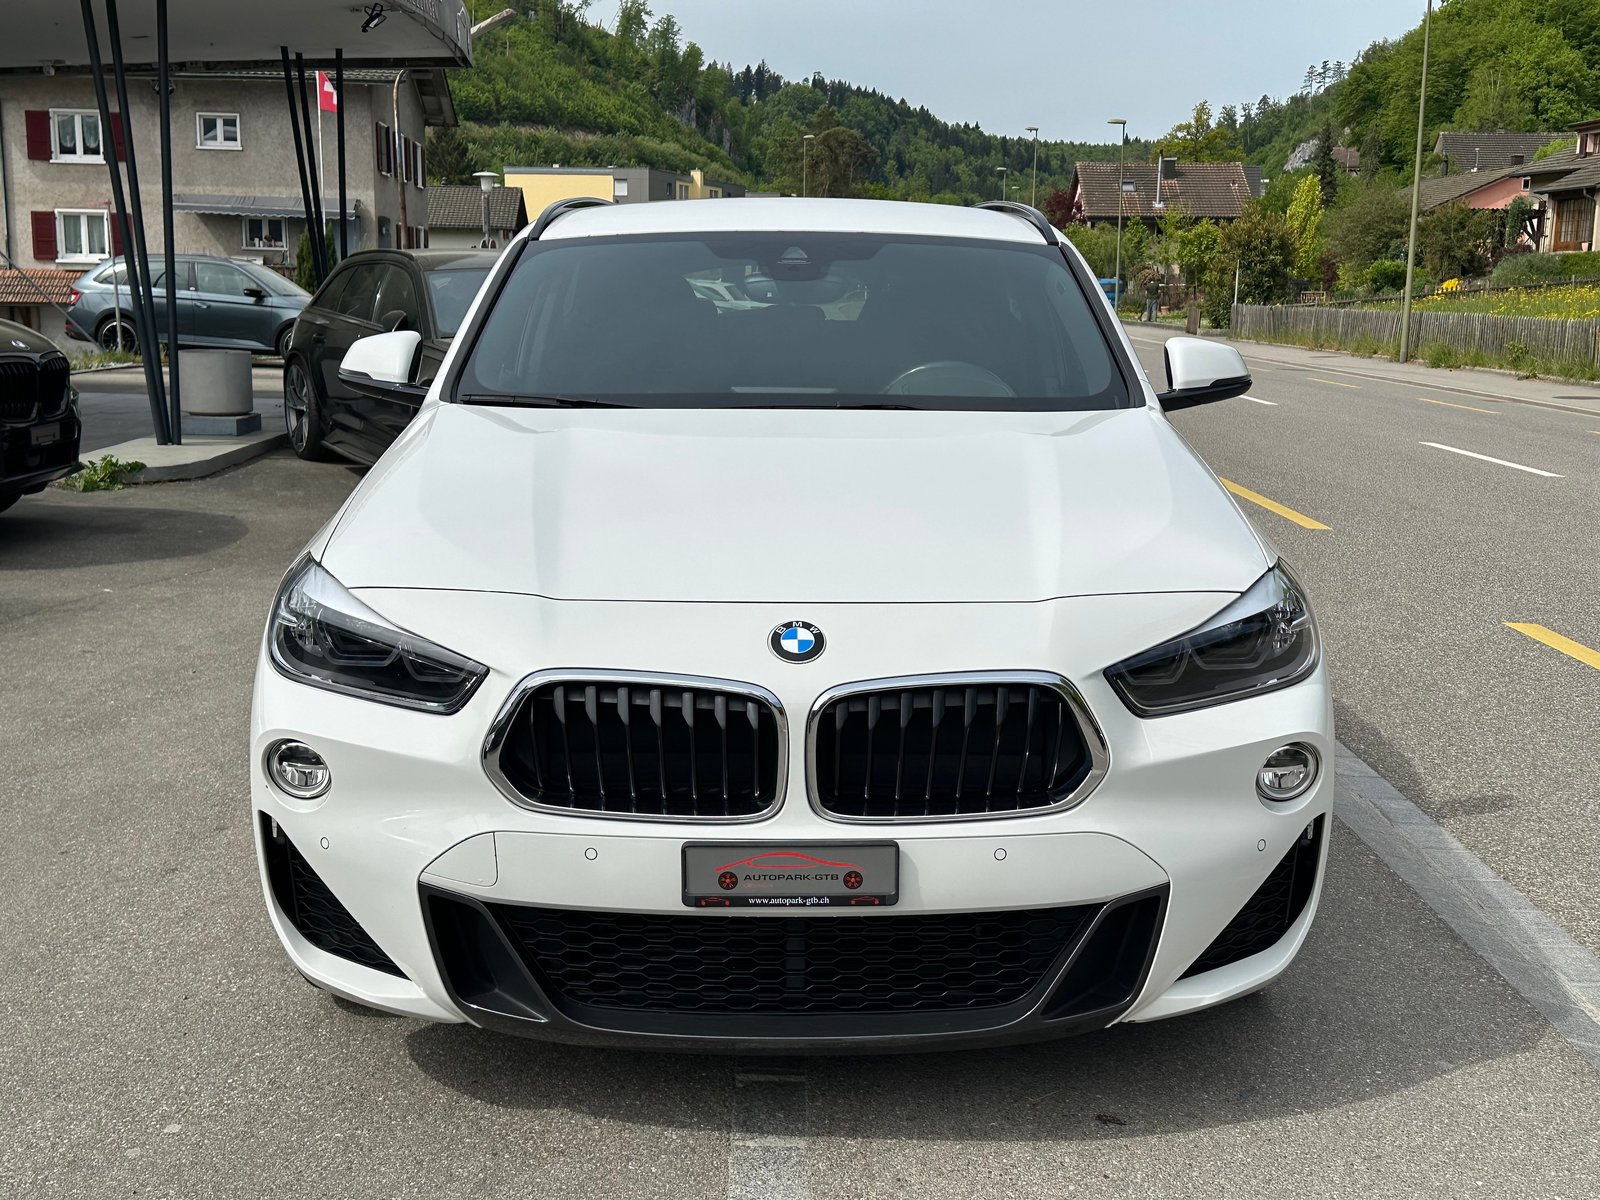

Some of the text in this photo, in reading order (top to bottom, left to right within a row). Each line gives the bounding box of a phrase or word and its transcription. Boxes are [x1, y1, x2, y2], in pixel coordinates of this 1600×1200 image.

[776, 621, 820, 634] BMW
[743, 873, 839, 881] AUTOPARK-GTB
[748, 896, 830, 906] www.autopark-gtb.ch
